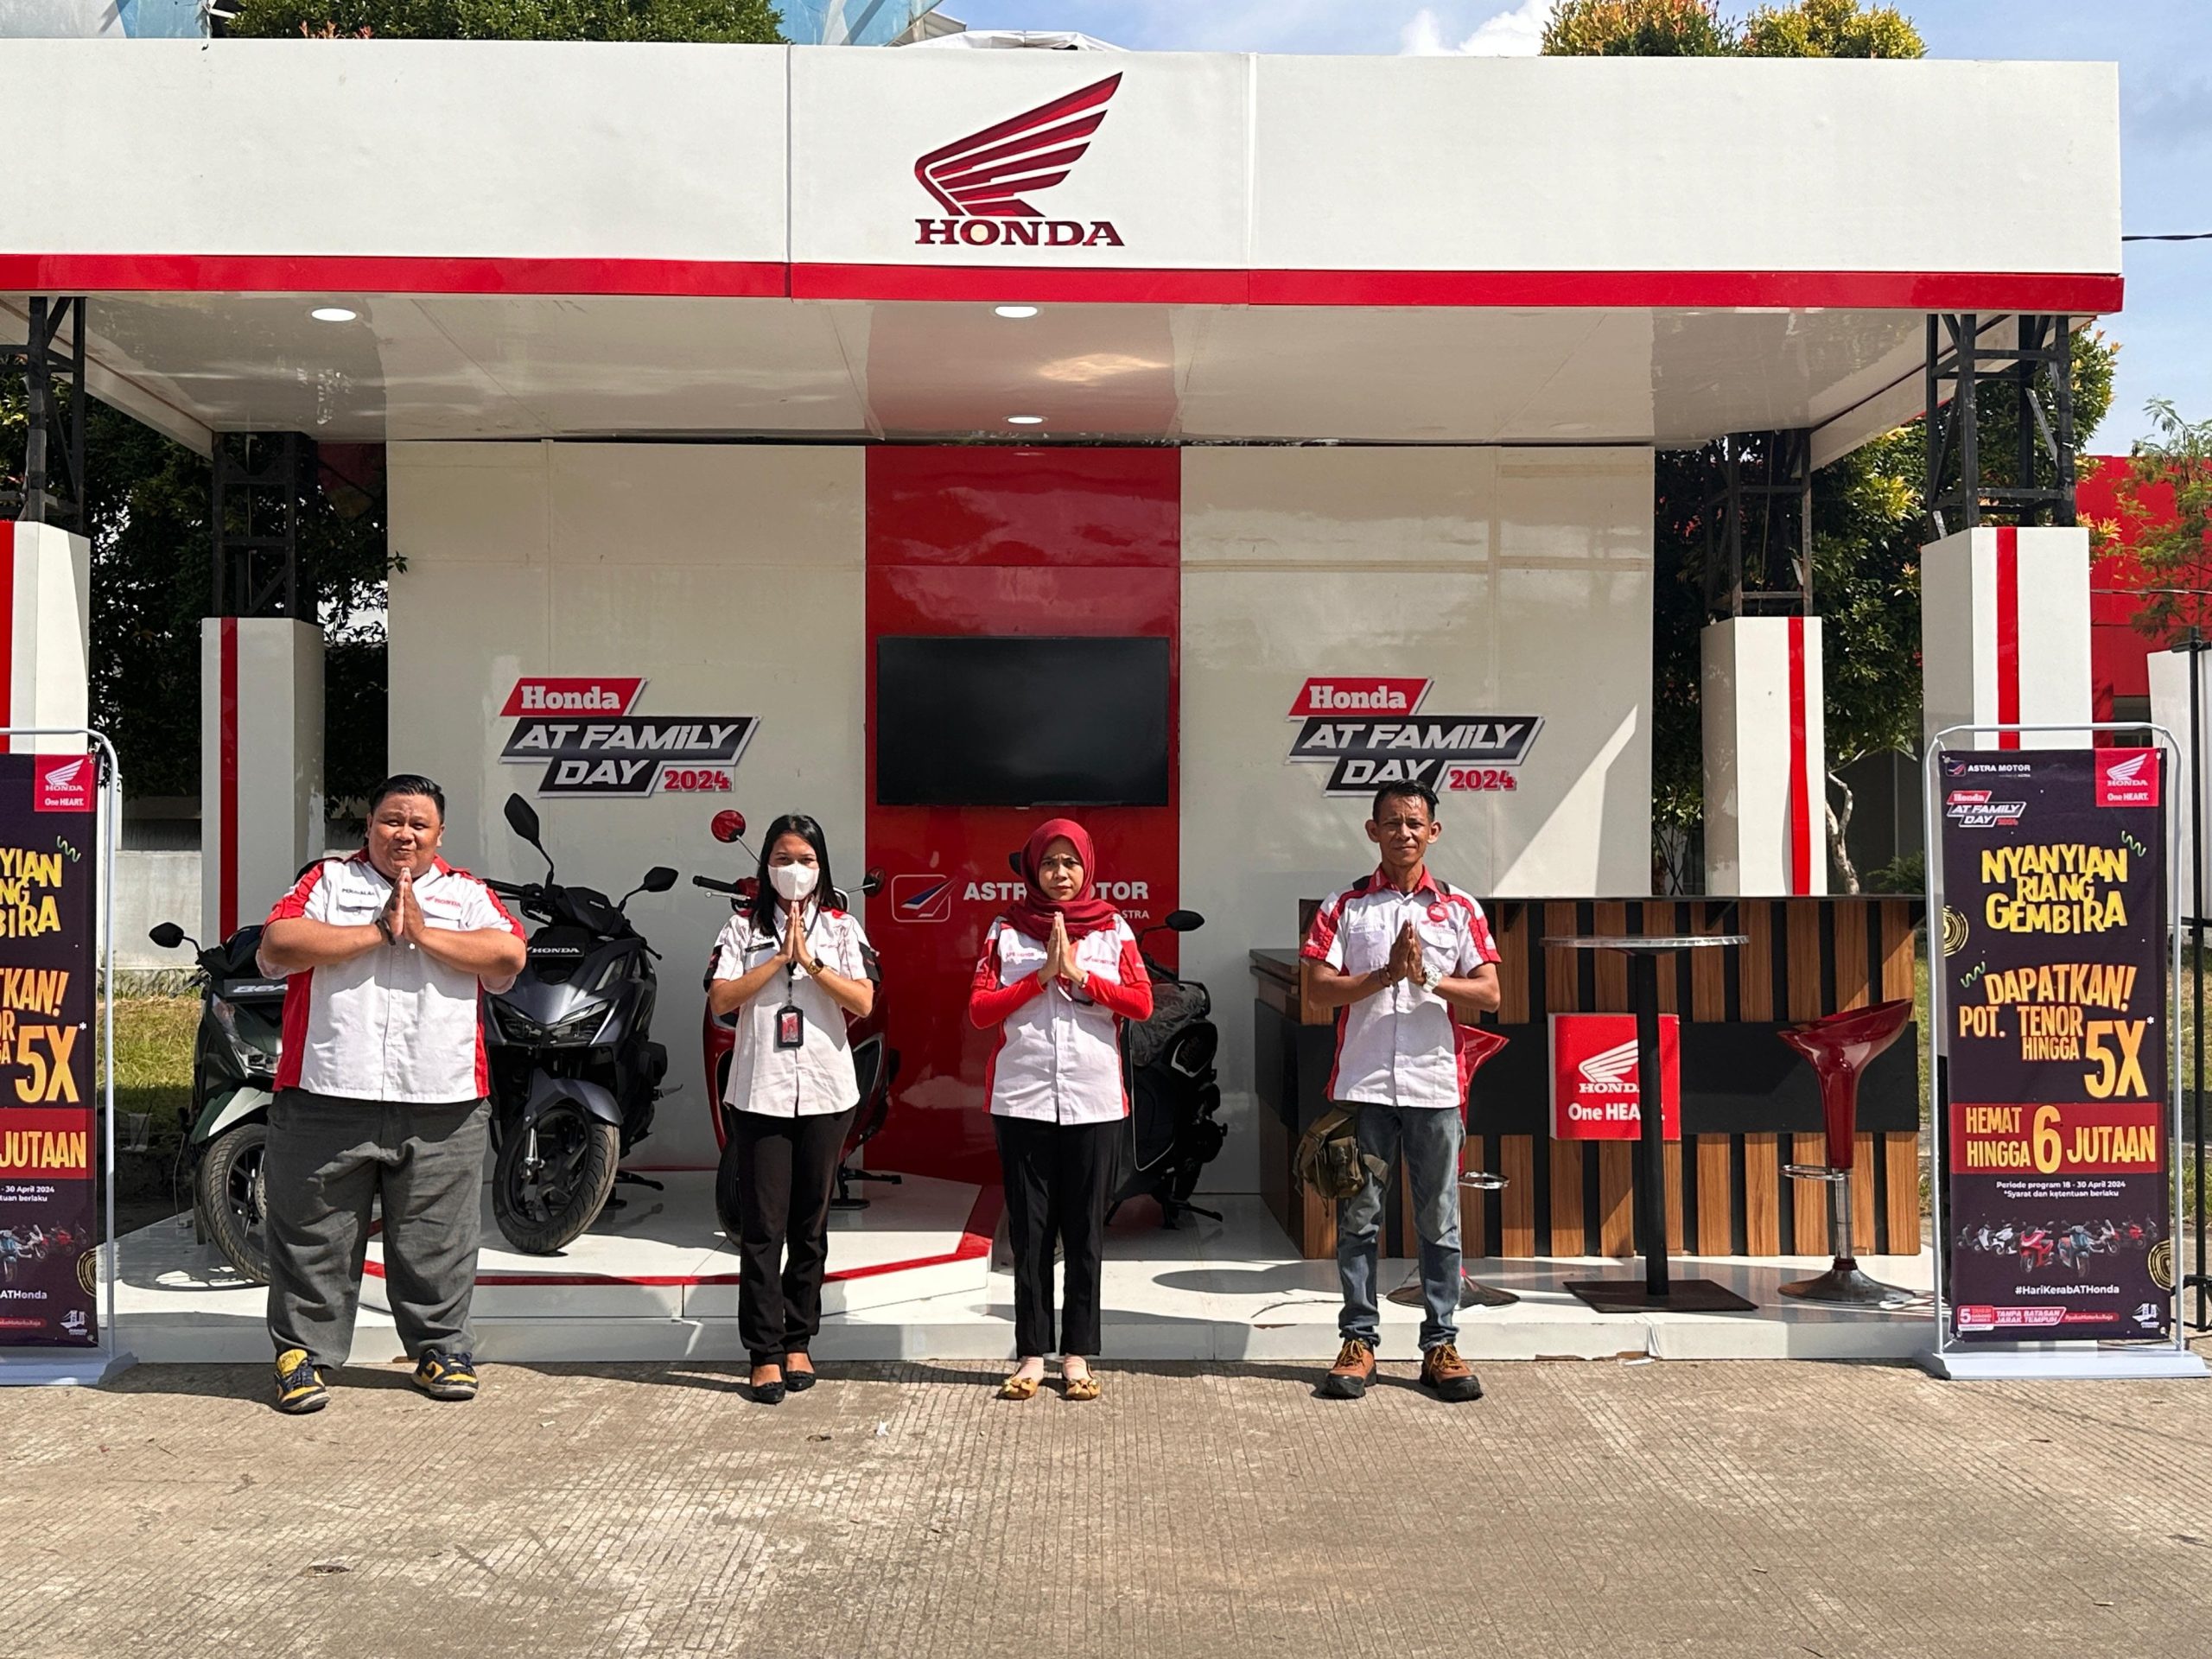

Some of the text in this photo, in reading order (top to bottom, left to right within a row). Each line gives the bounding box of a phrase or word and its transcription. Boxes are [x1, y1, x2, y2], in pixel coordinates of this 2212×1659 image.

[914, 219, 1126, 246] HONDA
[521, 686, 620, 709] Honda
[1309, 686, 1407, 709] Honda
[514, 725, 739, 750] AT FAMILY
[1301, 724, 1524, 749] AT FAMILY
[554, 760, 731, 791] DAY 2024
[1340, 760, 1516, 791] DAY 2024
[1952, 804, 2020, 813] AT FAMILY
[1954, 793, 1985, 802] Honda
[1964, 815, 1993, 824] DAY
[1981, 844, 2127, 883] NYANYIAN
[963, 881, 1148, 900] ASTR TOR
[2017, 873, 2094, 902] RIANG
[1122, 910, 1150, 919] STRA
[1986, 891, 2127, 934] GEMBIRA
[0, 968, 69, 1017] KAN!
[1984, 963, 2137, 1012] DAPATKAN!
[1959, 1006, 2084, 1037] POT. TENOR
[2022, 1037, 2080, 1060] HINGGA
[1579, 1083, 1640, 1093] HOND
[1568, 1103, 1602, 1120] One
[1966, 1107, 2022, 1134] HEMAT
[0, 1130, 86, 1168] JUTAAN
[2032, 1105, 2156, 1173] 6 JUTAAN
[1967, 1141, 2031, 1167] HINGGA
[2028, 1181, 2061, 1190] program
[2088, 1180, 2106, 1190] April
[2015, 1284, 2120, 1294] #HariKerabATHonda
[1960, 1308, 1971, 1323] 5
